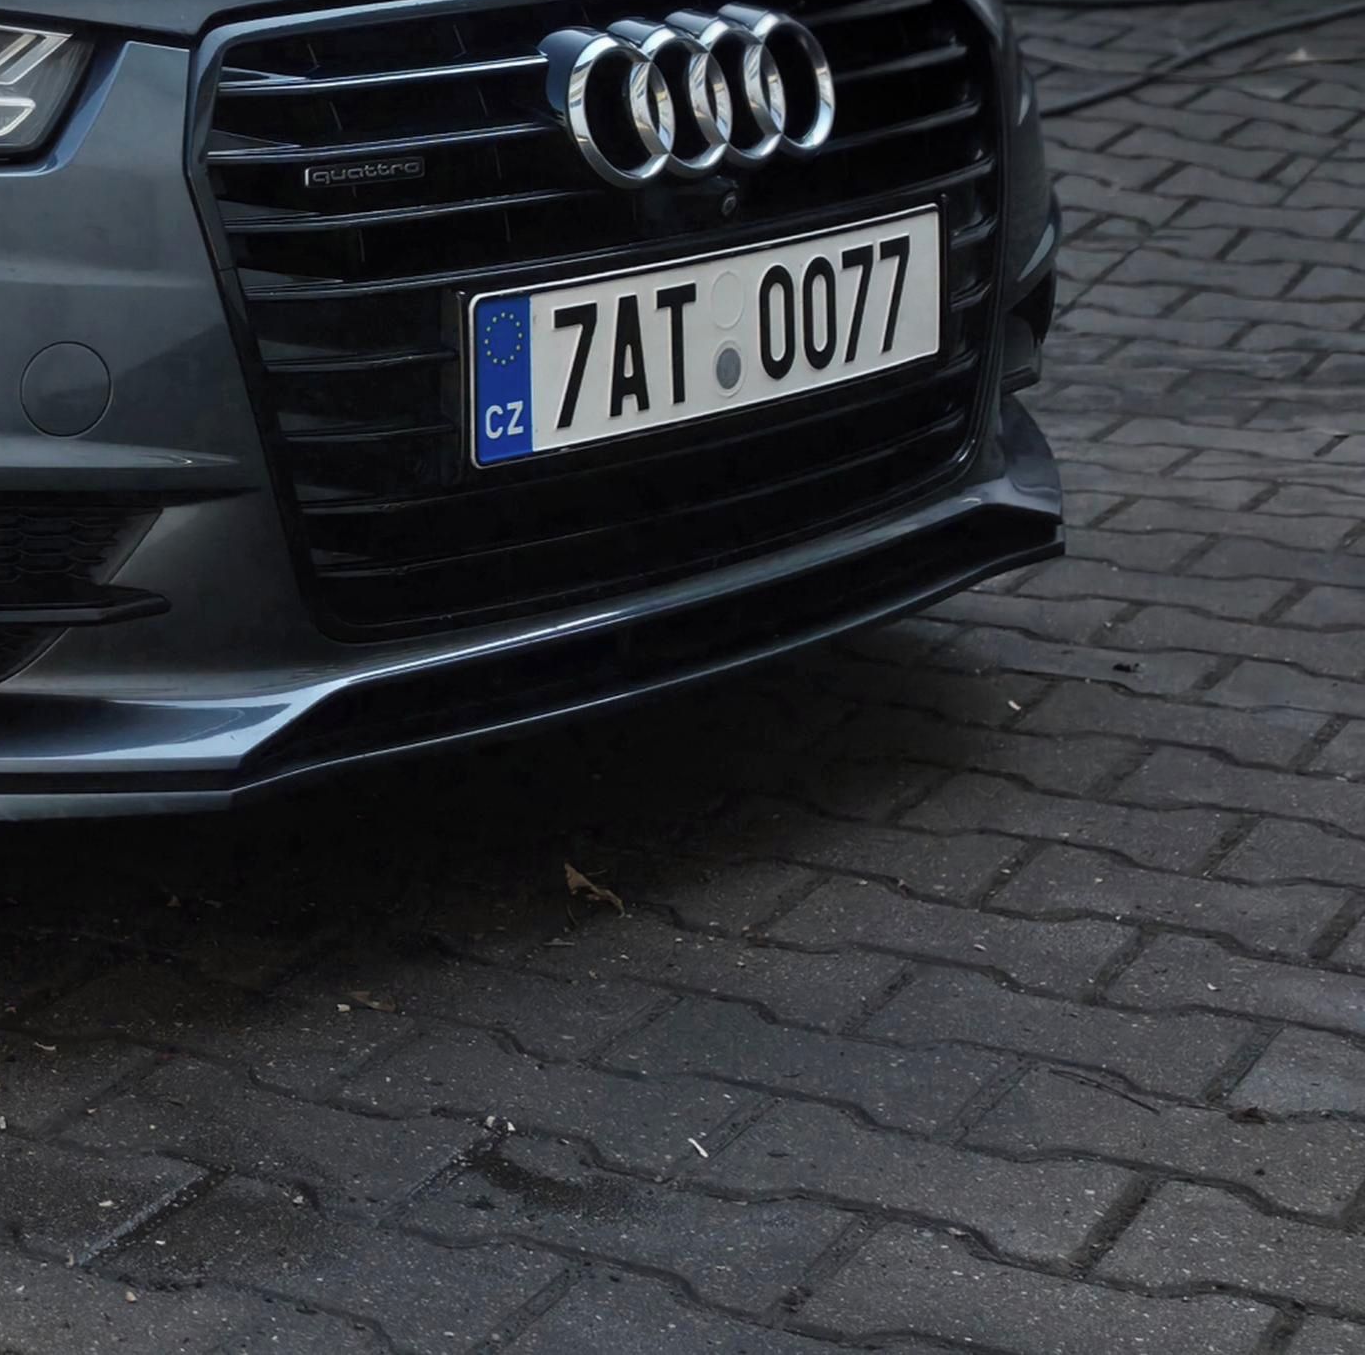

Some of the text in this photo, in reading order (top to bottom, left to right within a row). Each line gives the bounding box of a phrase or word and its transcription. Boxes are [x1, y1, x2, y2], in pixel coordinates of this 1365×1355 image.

[312, 162, 419, 185] quattro
[484, 234, 911, 440] CZ 7AT 0077
